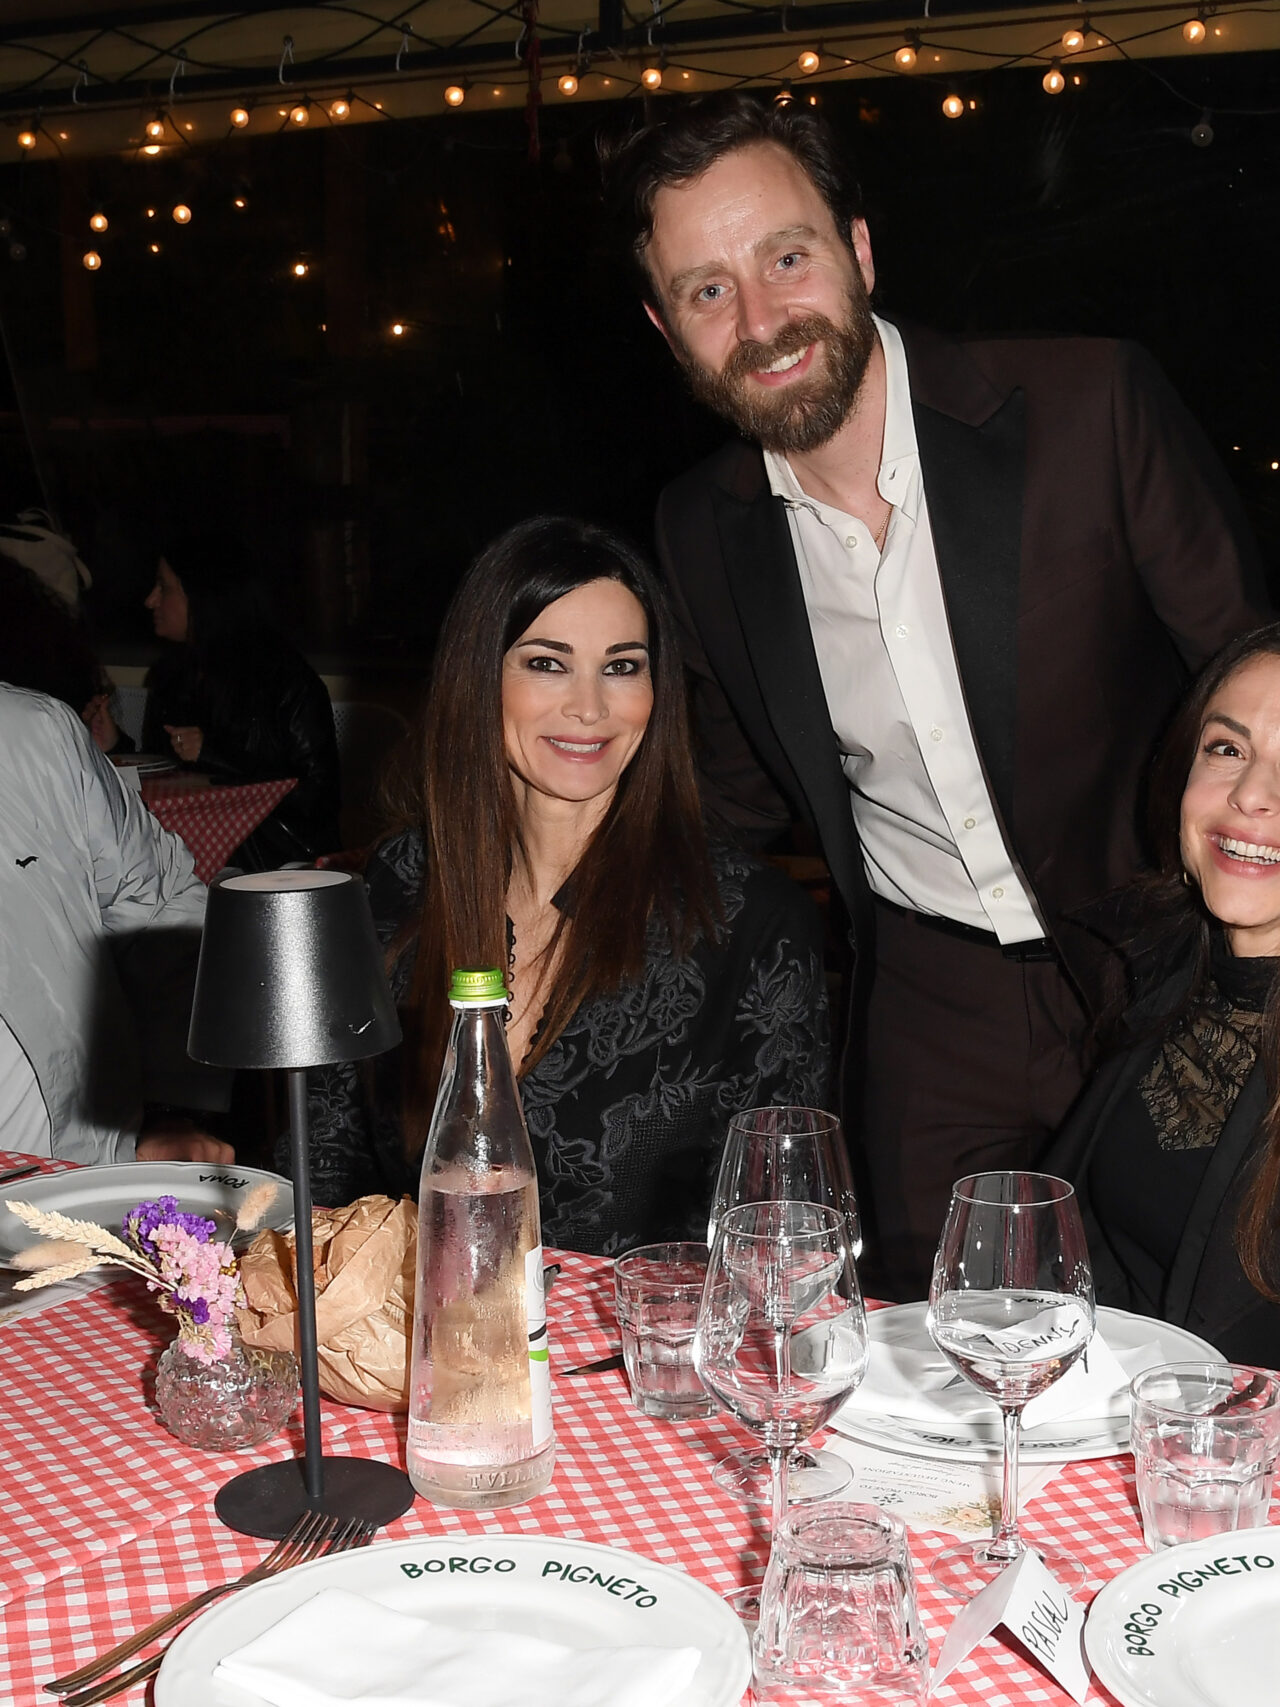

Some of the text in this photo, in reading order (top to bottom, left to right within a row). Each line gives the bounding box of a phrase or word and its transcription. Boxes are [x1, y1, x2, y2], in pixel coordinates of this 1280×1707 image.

[198, 1174, 250, 1189] ROMA
[400, 1556, 658, 1608] BORGO PIGNETO
[1124, 1555, 1275, 1657] BORGO PIGNETO
